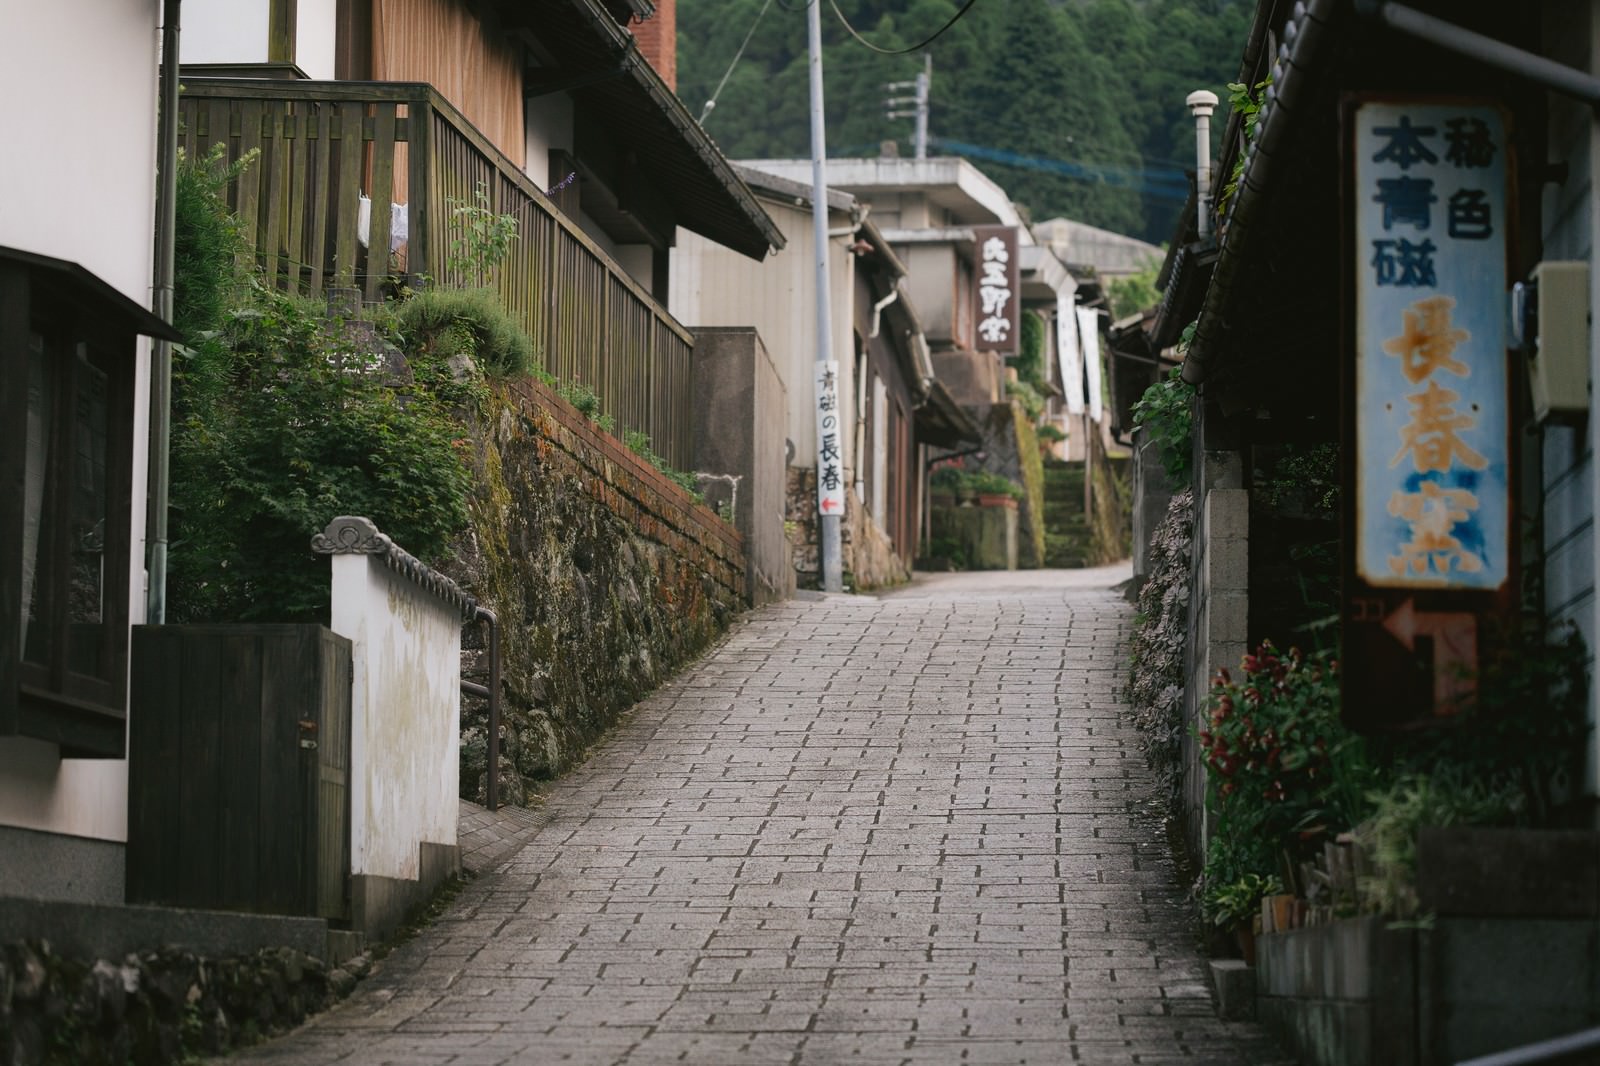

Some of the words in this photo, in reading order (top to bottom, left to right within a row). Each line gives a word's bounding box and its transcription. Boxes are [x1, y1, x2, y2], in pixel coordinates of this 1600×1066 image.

[1372, 116, 1437, 287] 本青磁
[1444, 116, 1496, 240] 秘色
[817, 366, 841, 491] 青磁の長春
[1383, 296, 1489, 574] 長春窯
